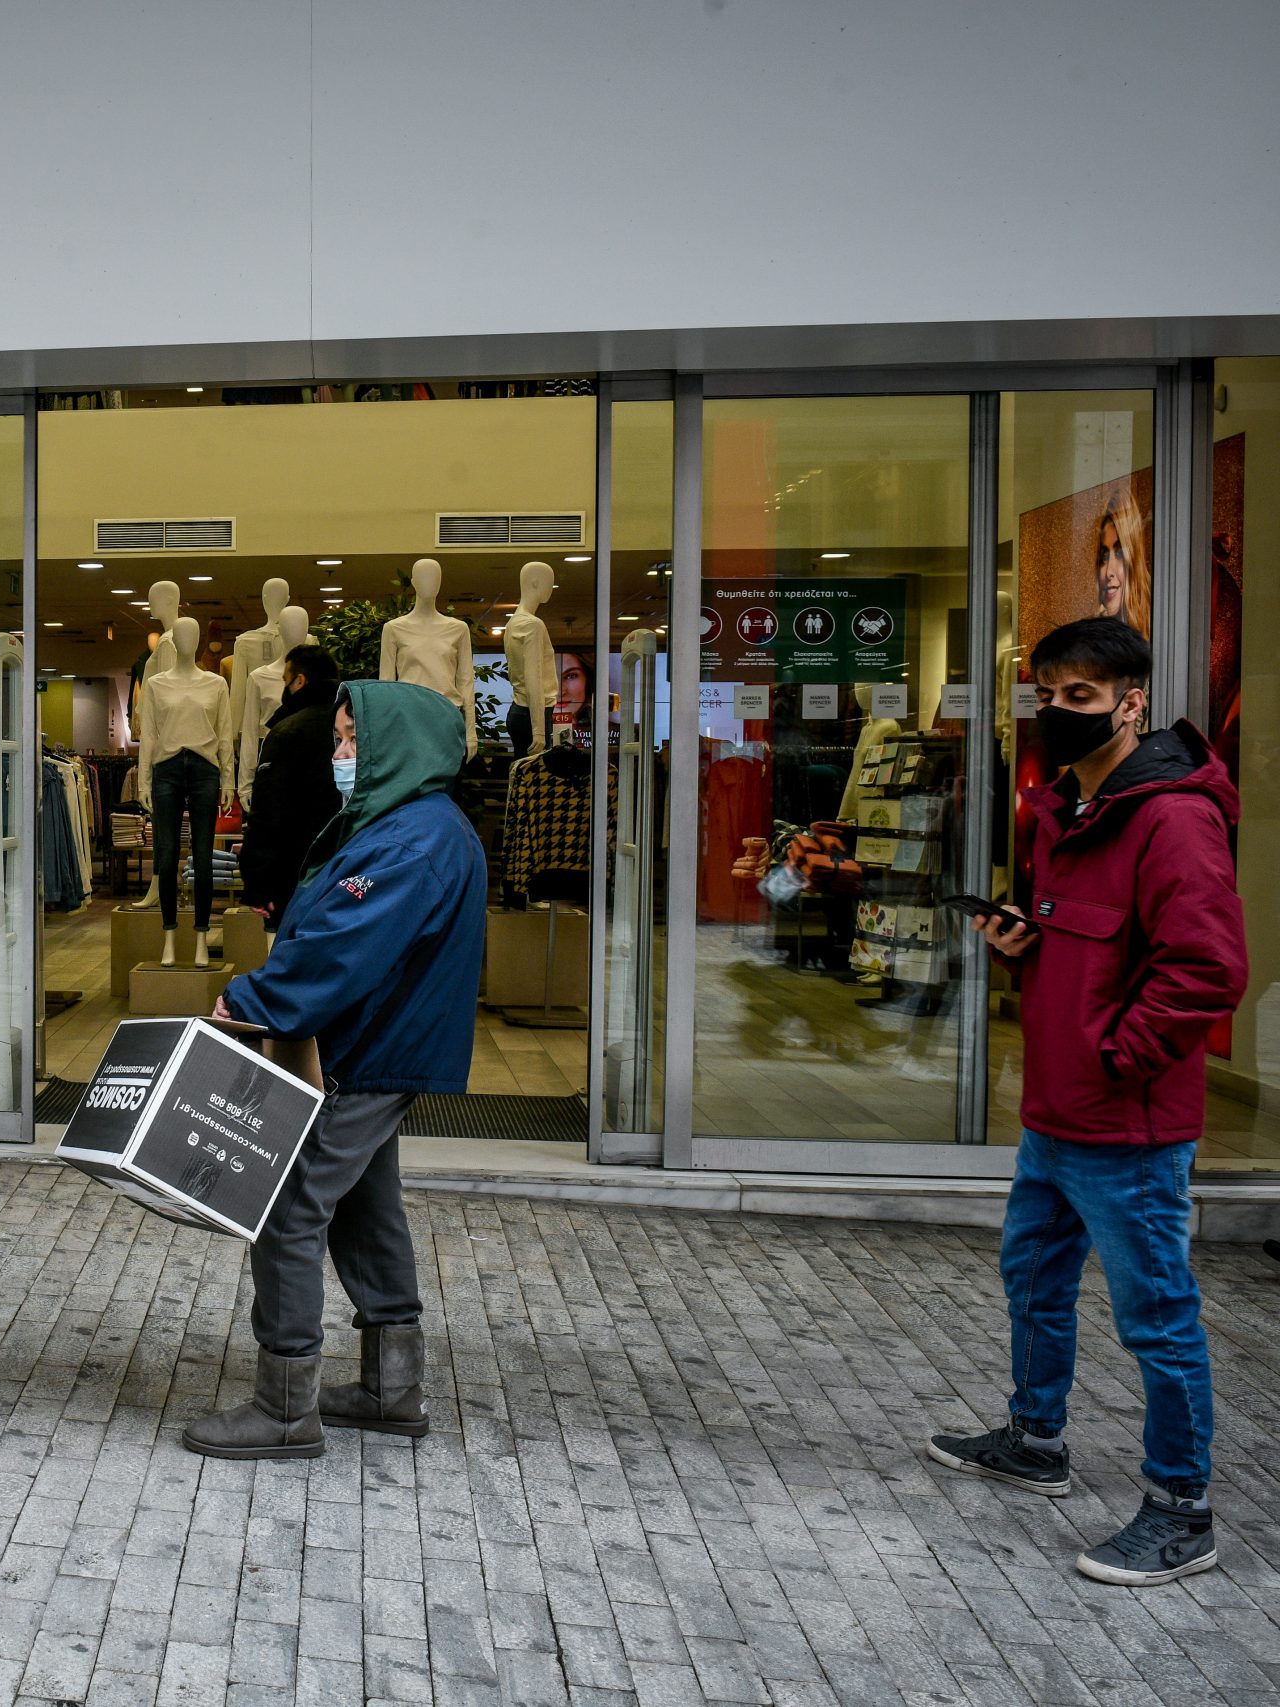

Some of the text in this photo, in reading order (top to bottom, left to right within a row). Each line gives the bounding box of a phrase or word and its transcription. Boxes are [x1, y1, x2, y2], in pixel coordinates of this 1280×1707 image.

[716, 590, 765, 599] Θυμηθείτε
[768, 590, 782, 598] ότι
[784, 590, 834, 599] χρειάζεται
[555, 714, 569, 722] €15
[574, 729, 591, 738] You
[339, 879, 363, 900] USA
[86, 1085, 146, 1111] COSMOS
[209, 1093, 226, 1108] 808
[226, 1103, 242, 1117] 808
[243, 1111, 263, 1129] 2811
[179, 1103, 272, 1160] www.cosmossport.gr
